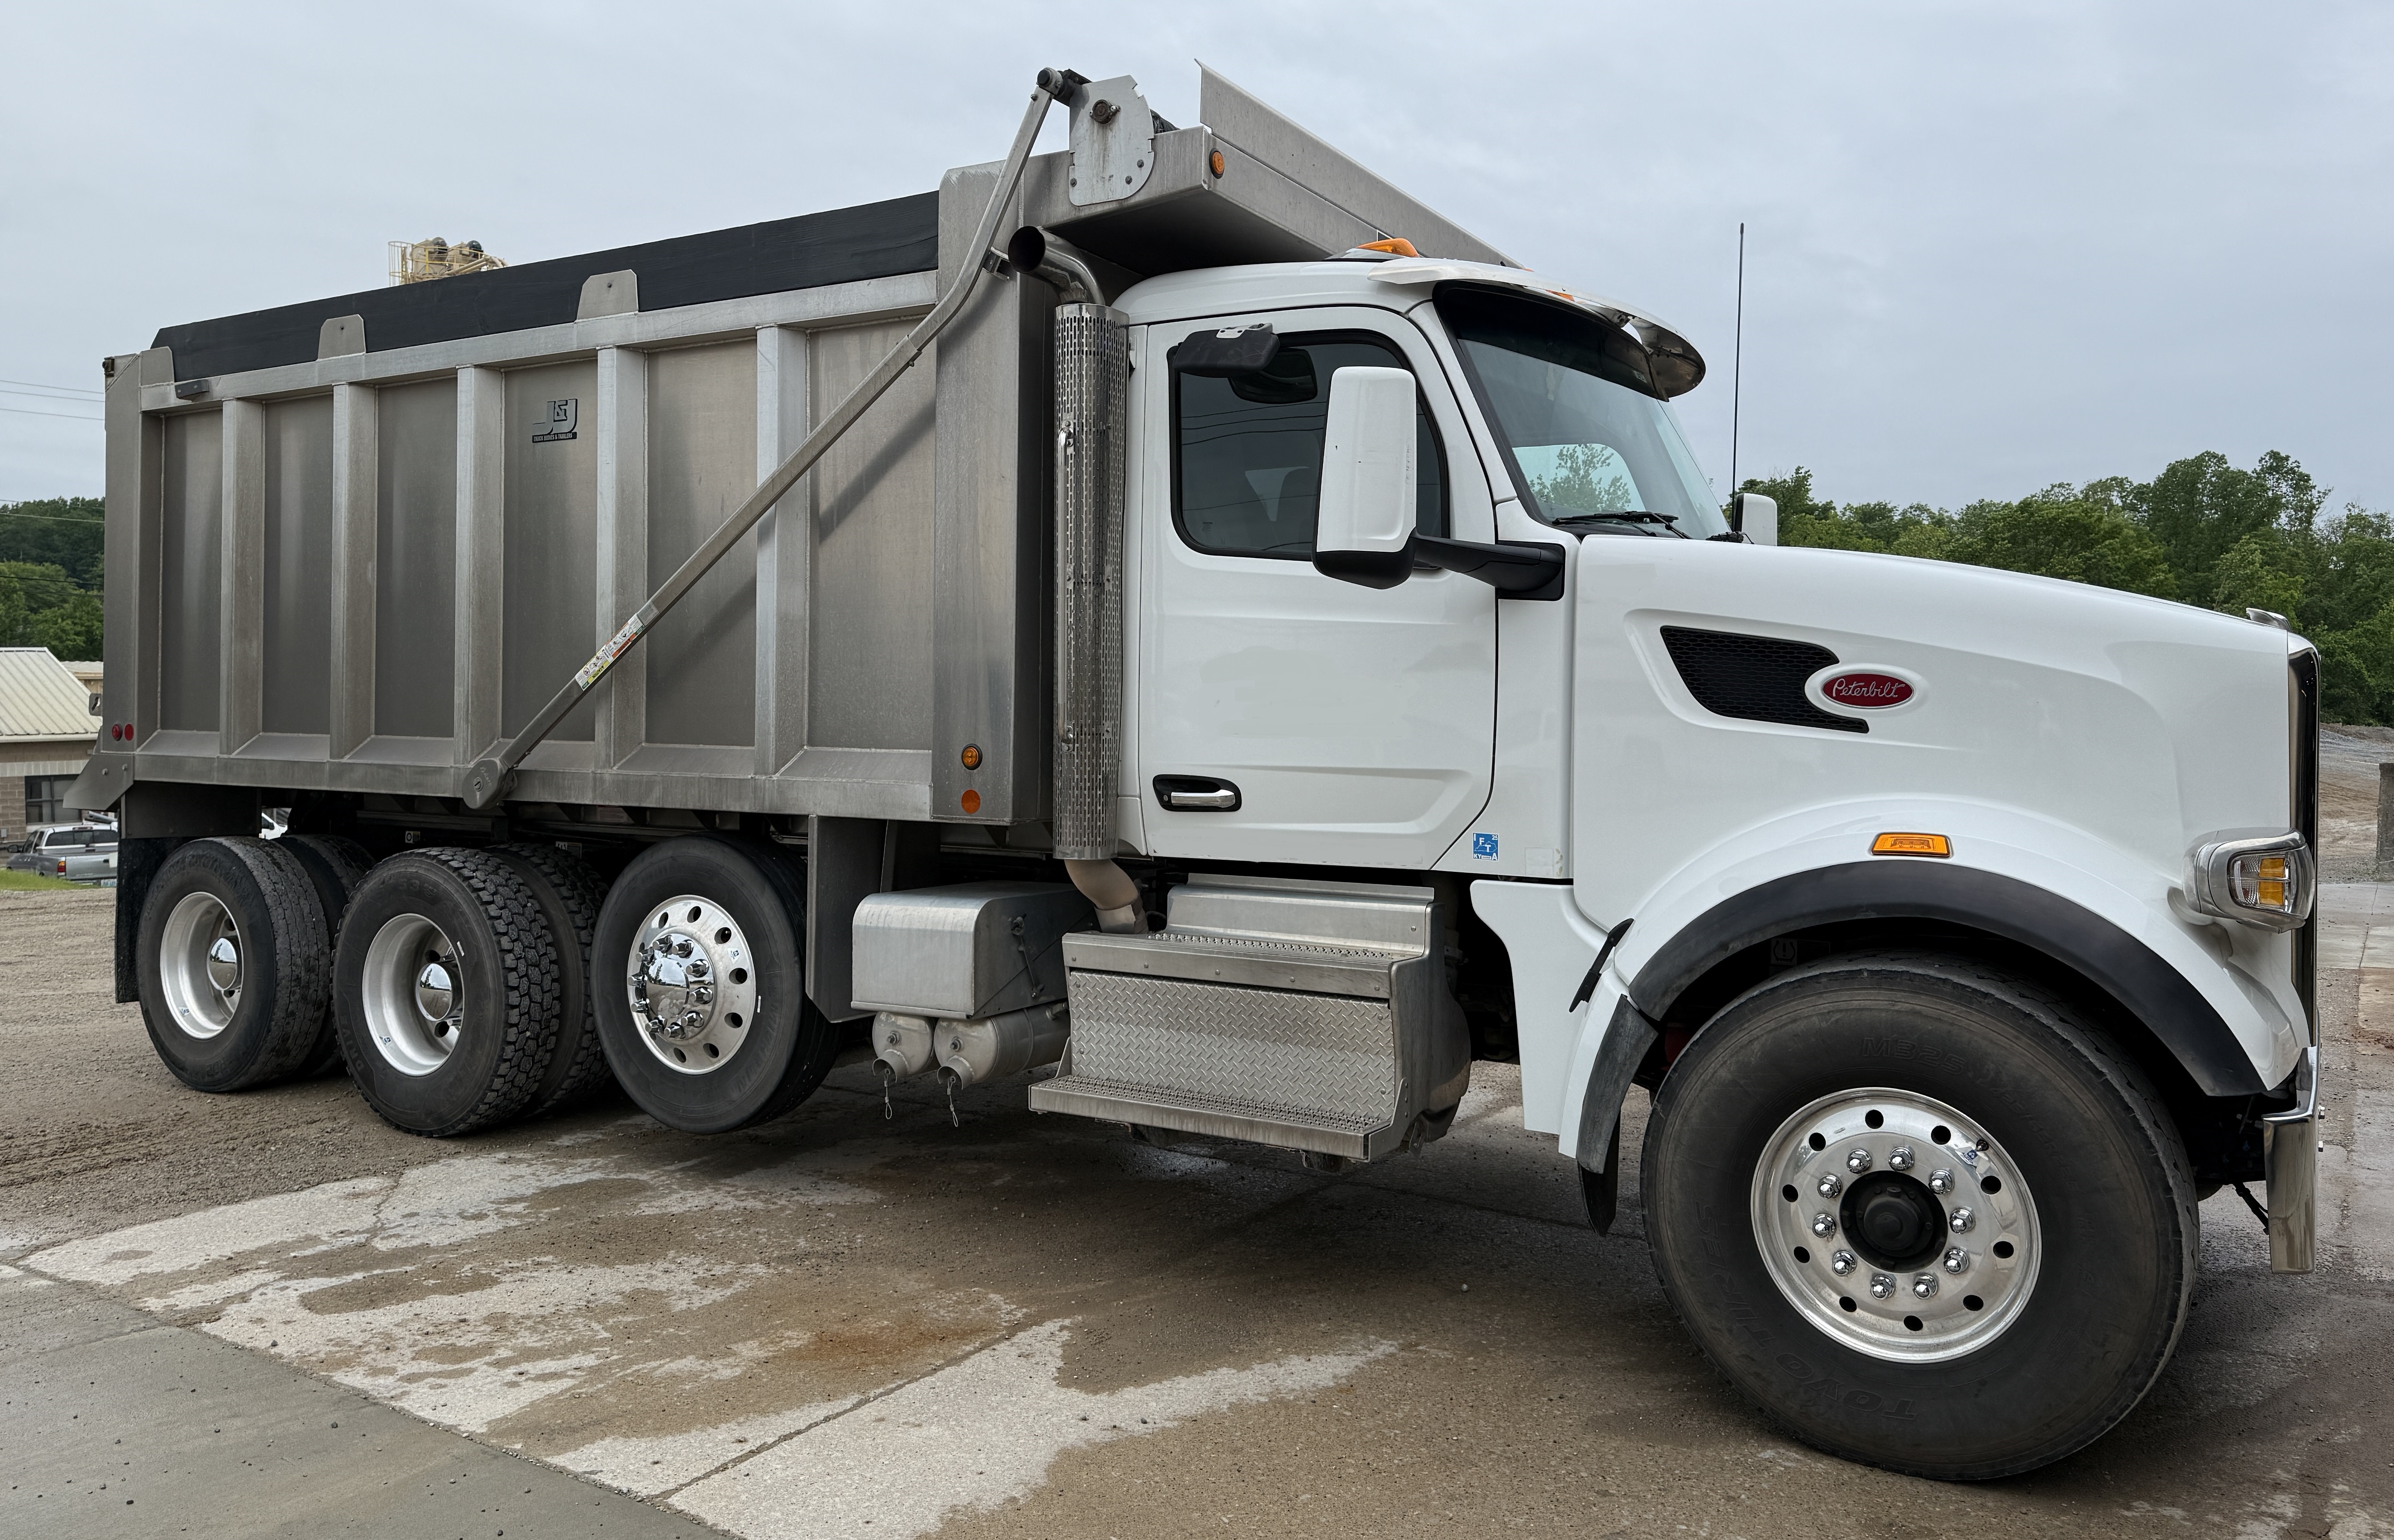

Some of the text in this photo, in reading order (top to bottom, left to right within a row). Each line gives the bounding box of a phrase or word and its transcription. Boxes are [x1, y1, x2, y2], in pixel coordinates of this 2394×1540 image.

[1832, 678, 1905, 697] Peterbilt
[340, 1015, 364, 1072] DRIVE
[1862, 1037, 1968, 1075] M325
[1696, 1200, 1917, 1420] TOYO TIRES
